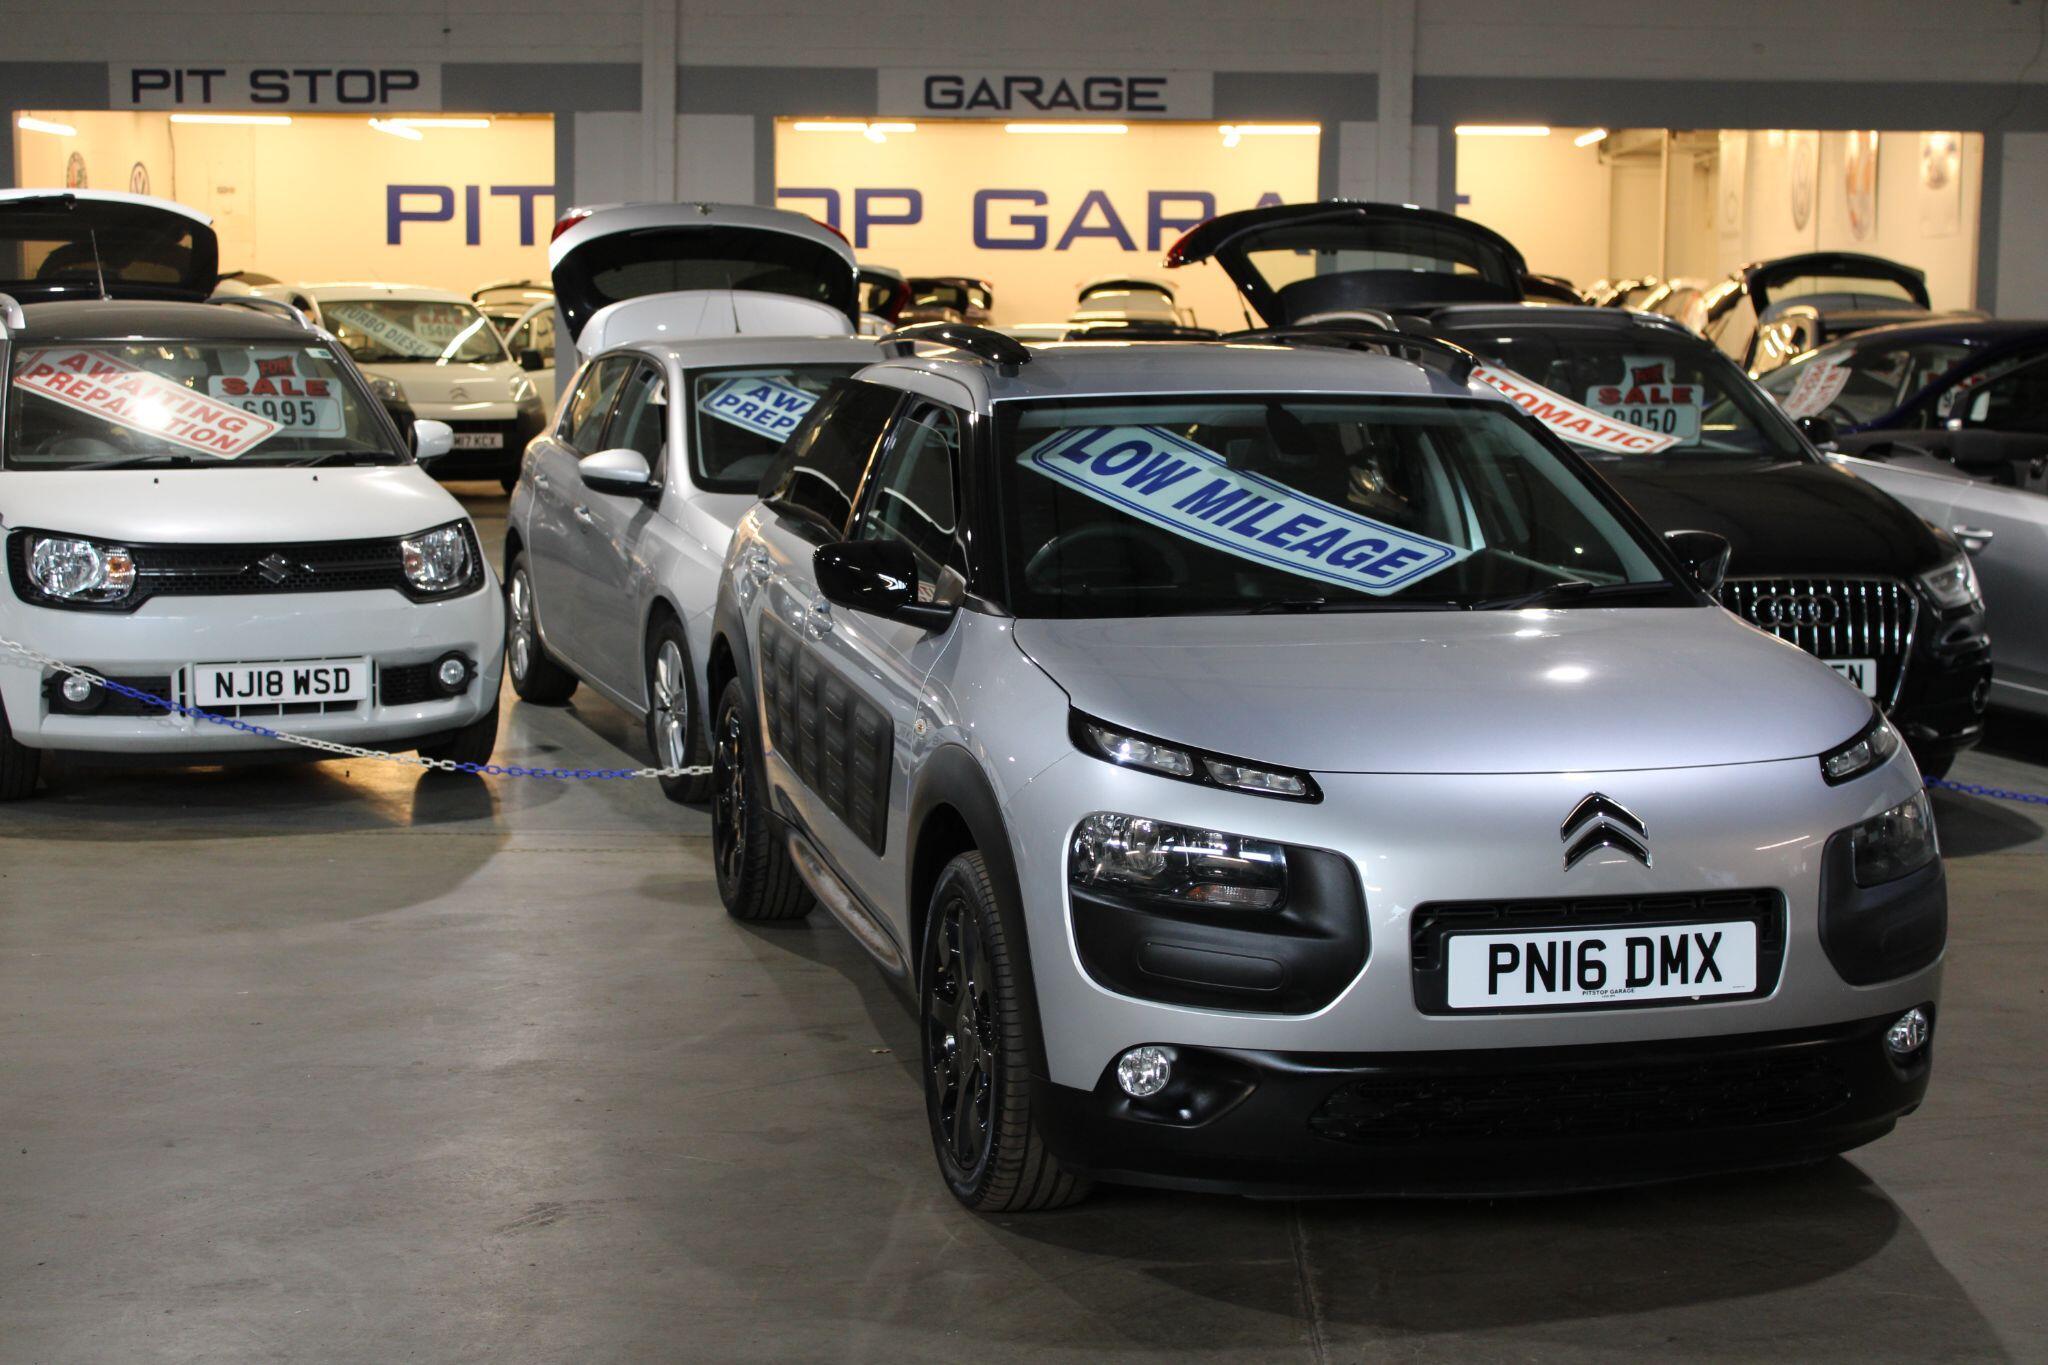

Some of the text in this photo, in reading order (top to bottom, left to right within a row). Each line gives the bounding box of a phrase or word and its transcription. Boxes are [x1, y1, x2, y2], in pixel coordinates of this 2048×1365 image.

[131, 69, 420, 103] PIT STOP
[924, 75, 1168, 111] GARAGE
[386, 184, 554, 246] PIT
[58, 352, 249, 433] AWAITING
[222, 377, 331, 396] SALE
[1598, 386, 1694, 405] SALE
[1058, 425, 1427, 578] LOW MILEAGE
[215, 667, 351, 699] NJ18 WSD
[1488, 931, 1723, 996] PN16 DMX
